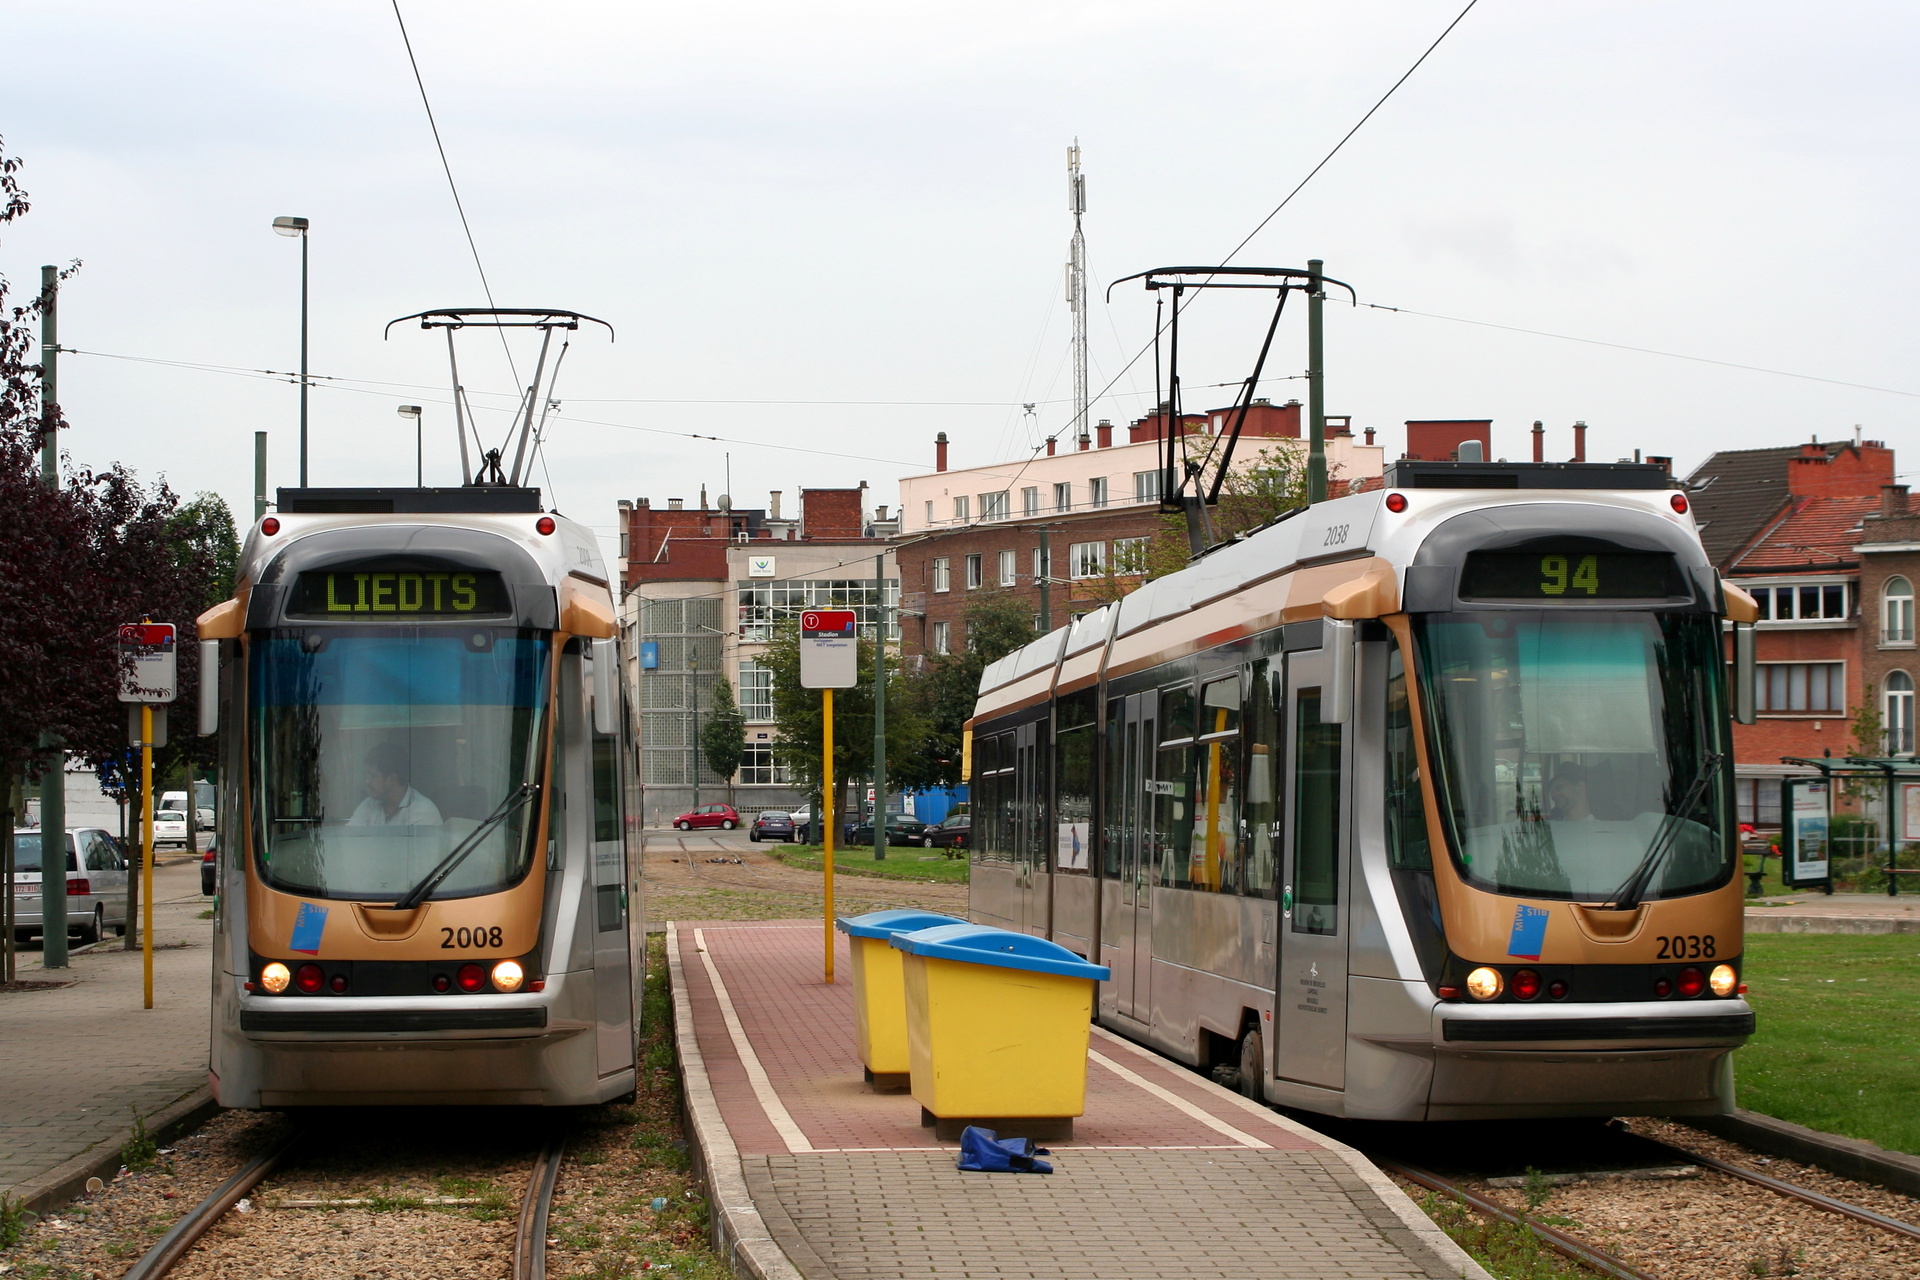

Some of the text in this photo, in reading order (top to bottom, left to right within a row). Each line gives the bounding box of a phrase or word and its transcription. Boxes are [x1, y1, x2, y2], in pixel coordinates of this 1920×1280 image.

[1323, 524, 1350, 546] 2038
[1541, 555, 1599, 595] 94
[327, 573, 476, 611] LIEDTS
[309, 905, 328, 914] STIB
[1514, 906, 1524, 931] MIVB
[1527, 908, 1548, 917] STIB
[441, 926, 503, 949] 2008
[1656, 935, 1716, 959] 2038
